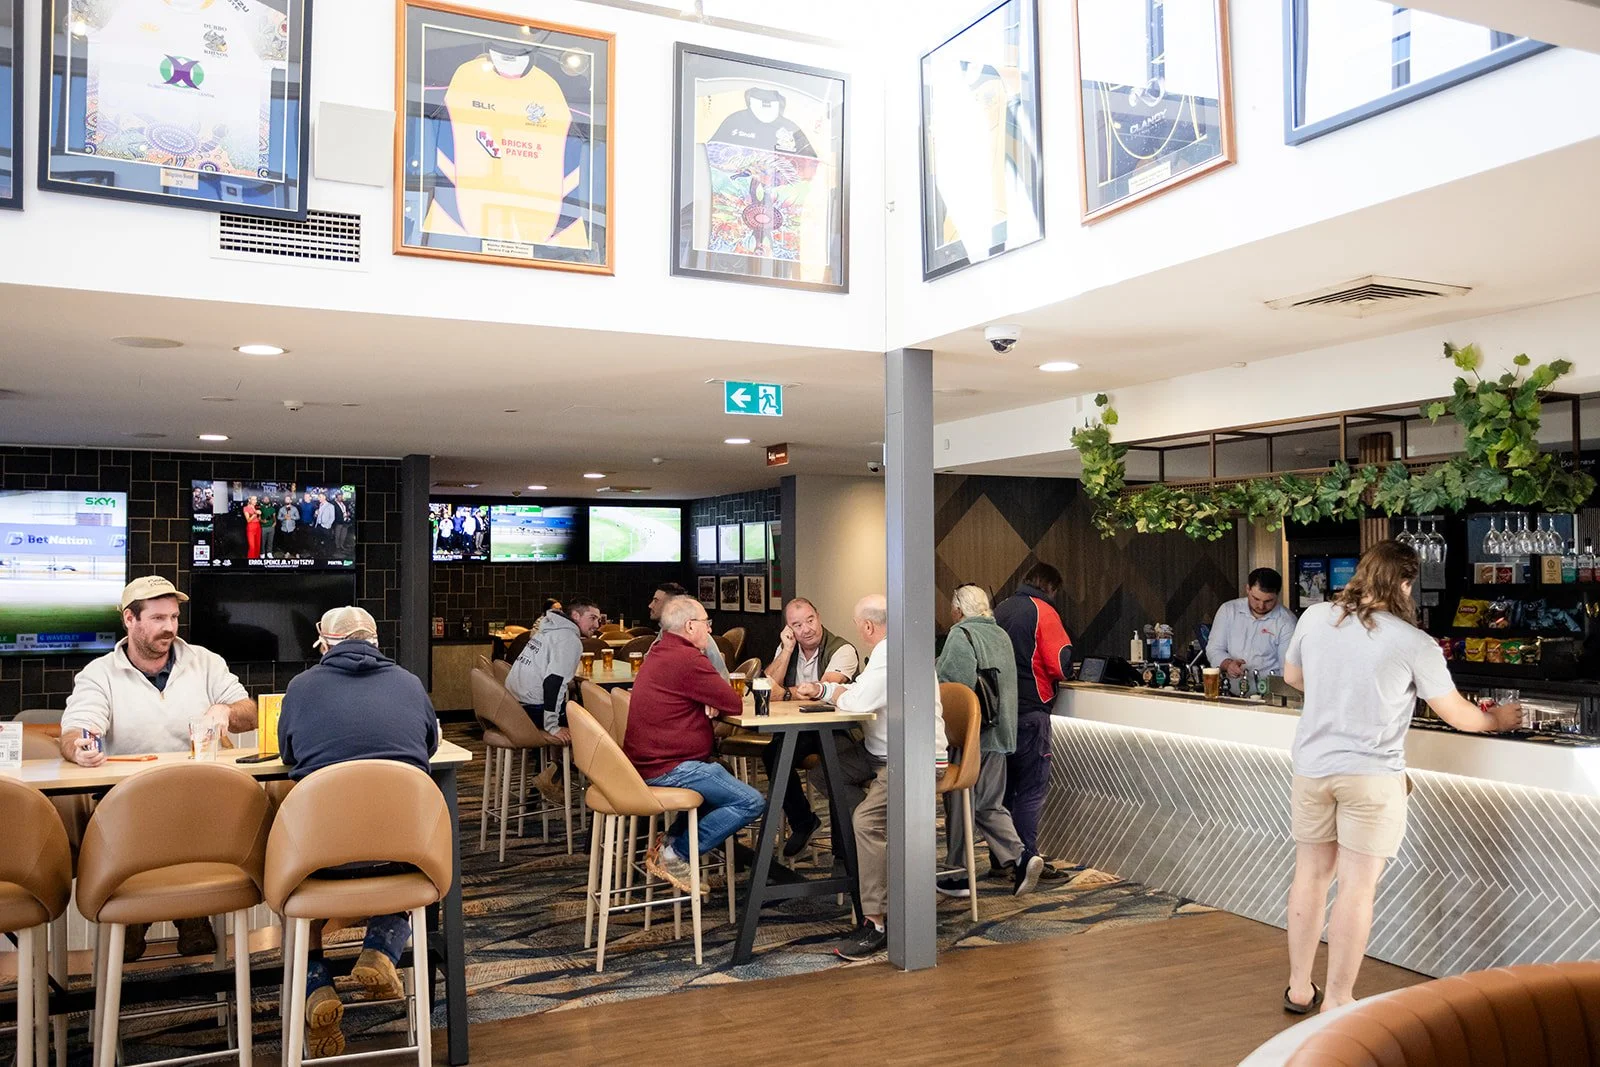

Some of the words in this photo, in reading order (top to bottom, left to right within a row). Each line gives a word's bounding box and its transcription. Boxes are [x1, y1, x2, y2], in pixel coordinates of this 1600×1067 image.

[472, 100, 496, 111] BLK
[501, 138, 533, 149] BRICKS
[536, 143, 542, 151] &
[506, 148, 539, 159] PAVERS
